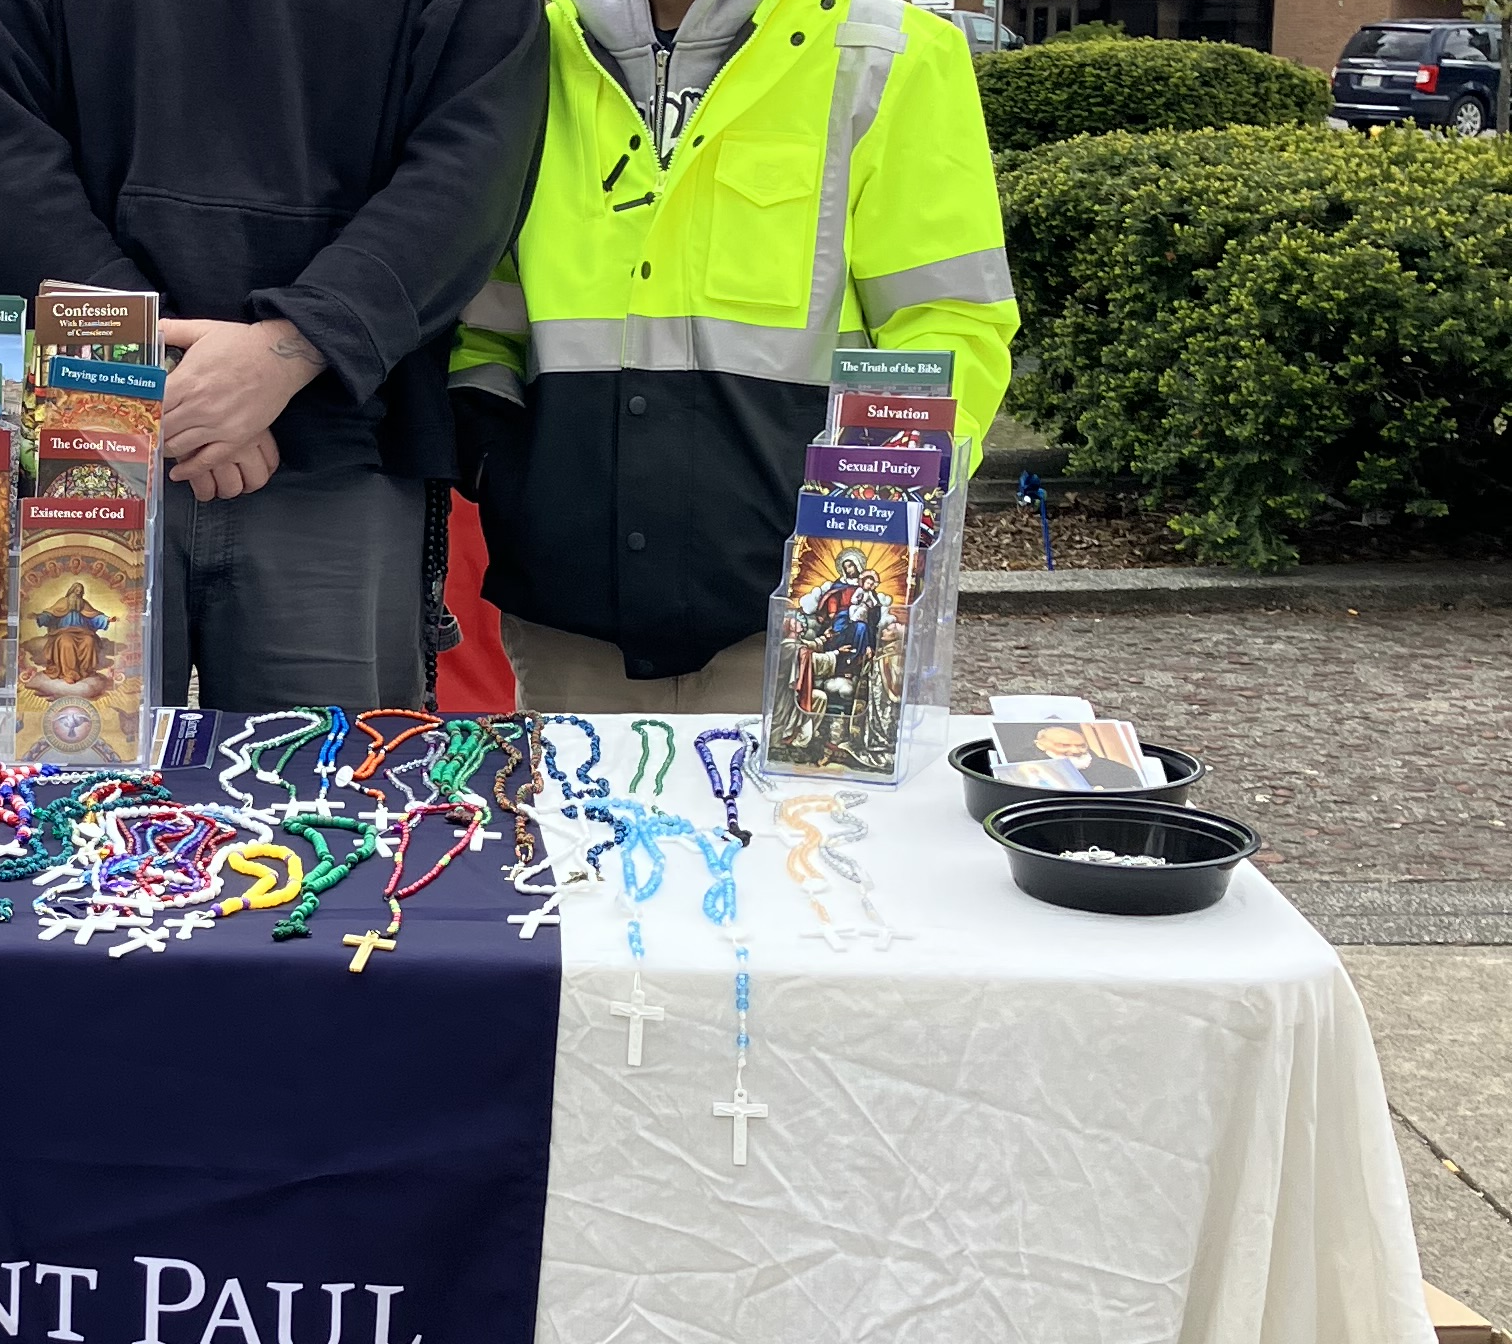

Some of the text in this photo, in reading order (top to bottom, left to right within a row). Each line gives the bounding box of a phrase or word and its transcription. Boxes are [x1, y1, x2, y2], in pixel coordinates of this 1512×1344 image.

[52, 303, 128, 317] Confession
[59, 319, 121, 328] With Examination
[67, 329, 113, 337] of Conscience
[840, 361, 942, 374] The Truth of the Bible
[61, 366, 156, 389] Praying to the Saints
[867, 405, 929, 420] Salvation
[50, 437, 136, 453] The Good News
[838, 459, 921, 478] Sexual Purity
[30, 506, 125, 520] Existence of God
[822, 501, 895, 522] How to Pray
[826, 517, 888, 536] the Rosary
